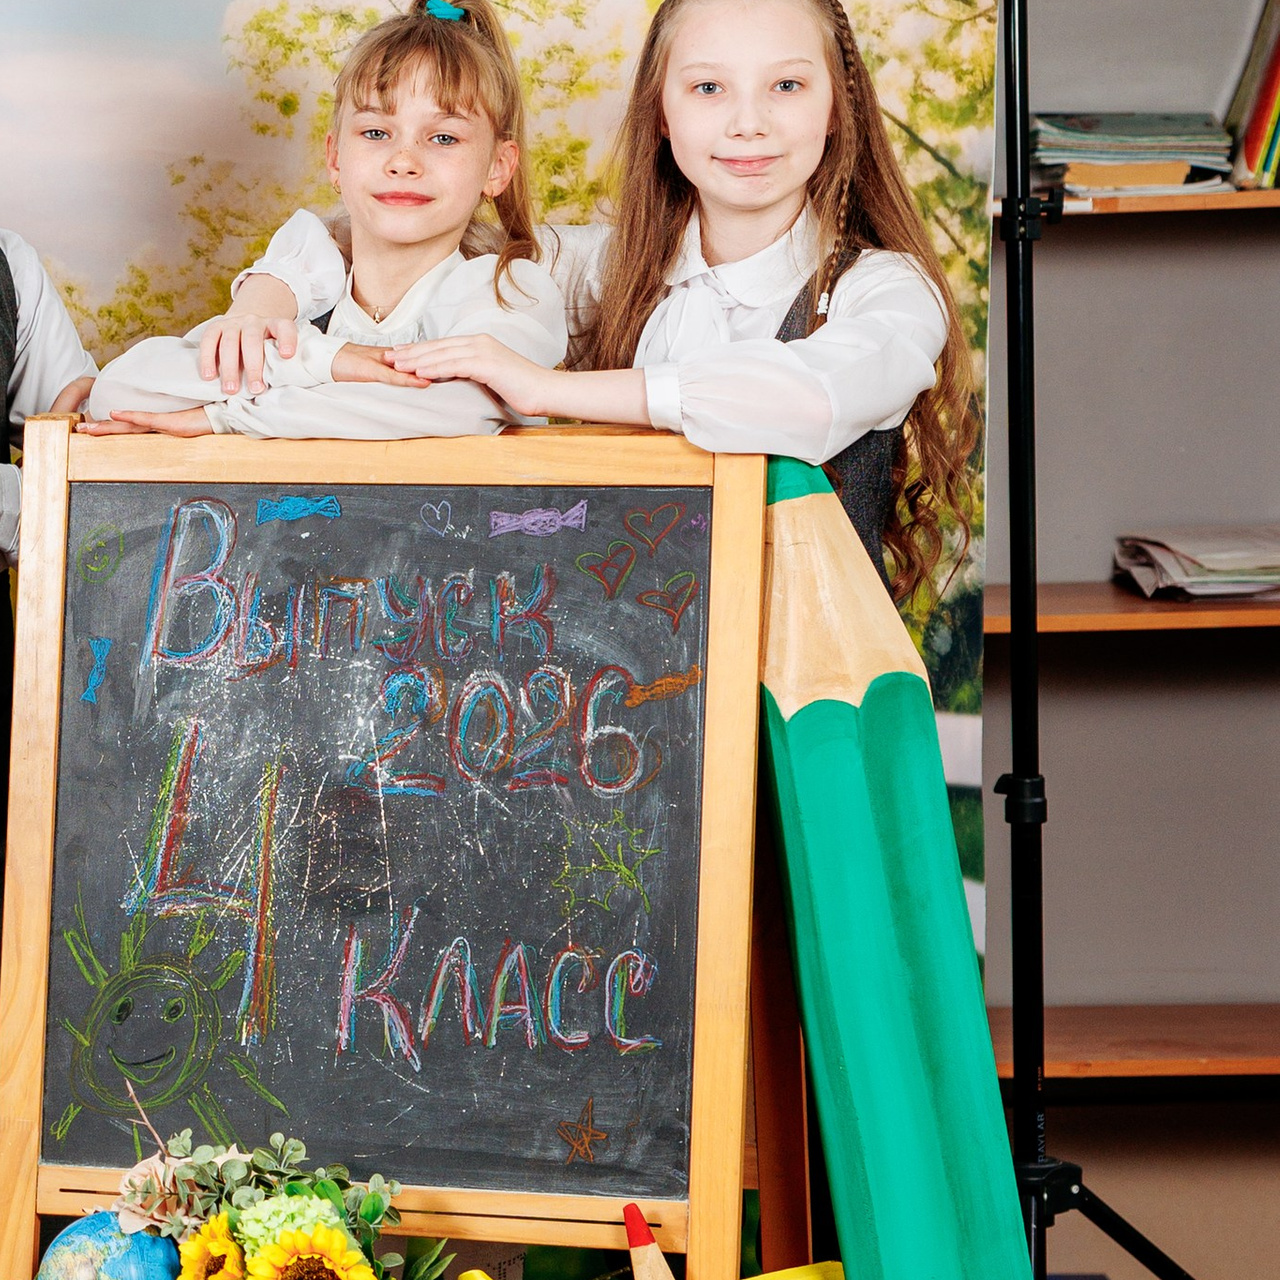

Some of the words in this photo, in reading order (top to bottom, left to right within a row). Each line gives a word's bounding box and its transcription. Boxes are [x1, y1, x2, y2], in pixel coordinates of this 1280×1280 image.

[142, 495, 560, 680] Выпуск
[345, 663, 656, 797] 2026
[123, 718, 279, 1046] 4
